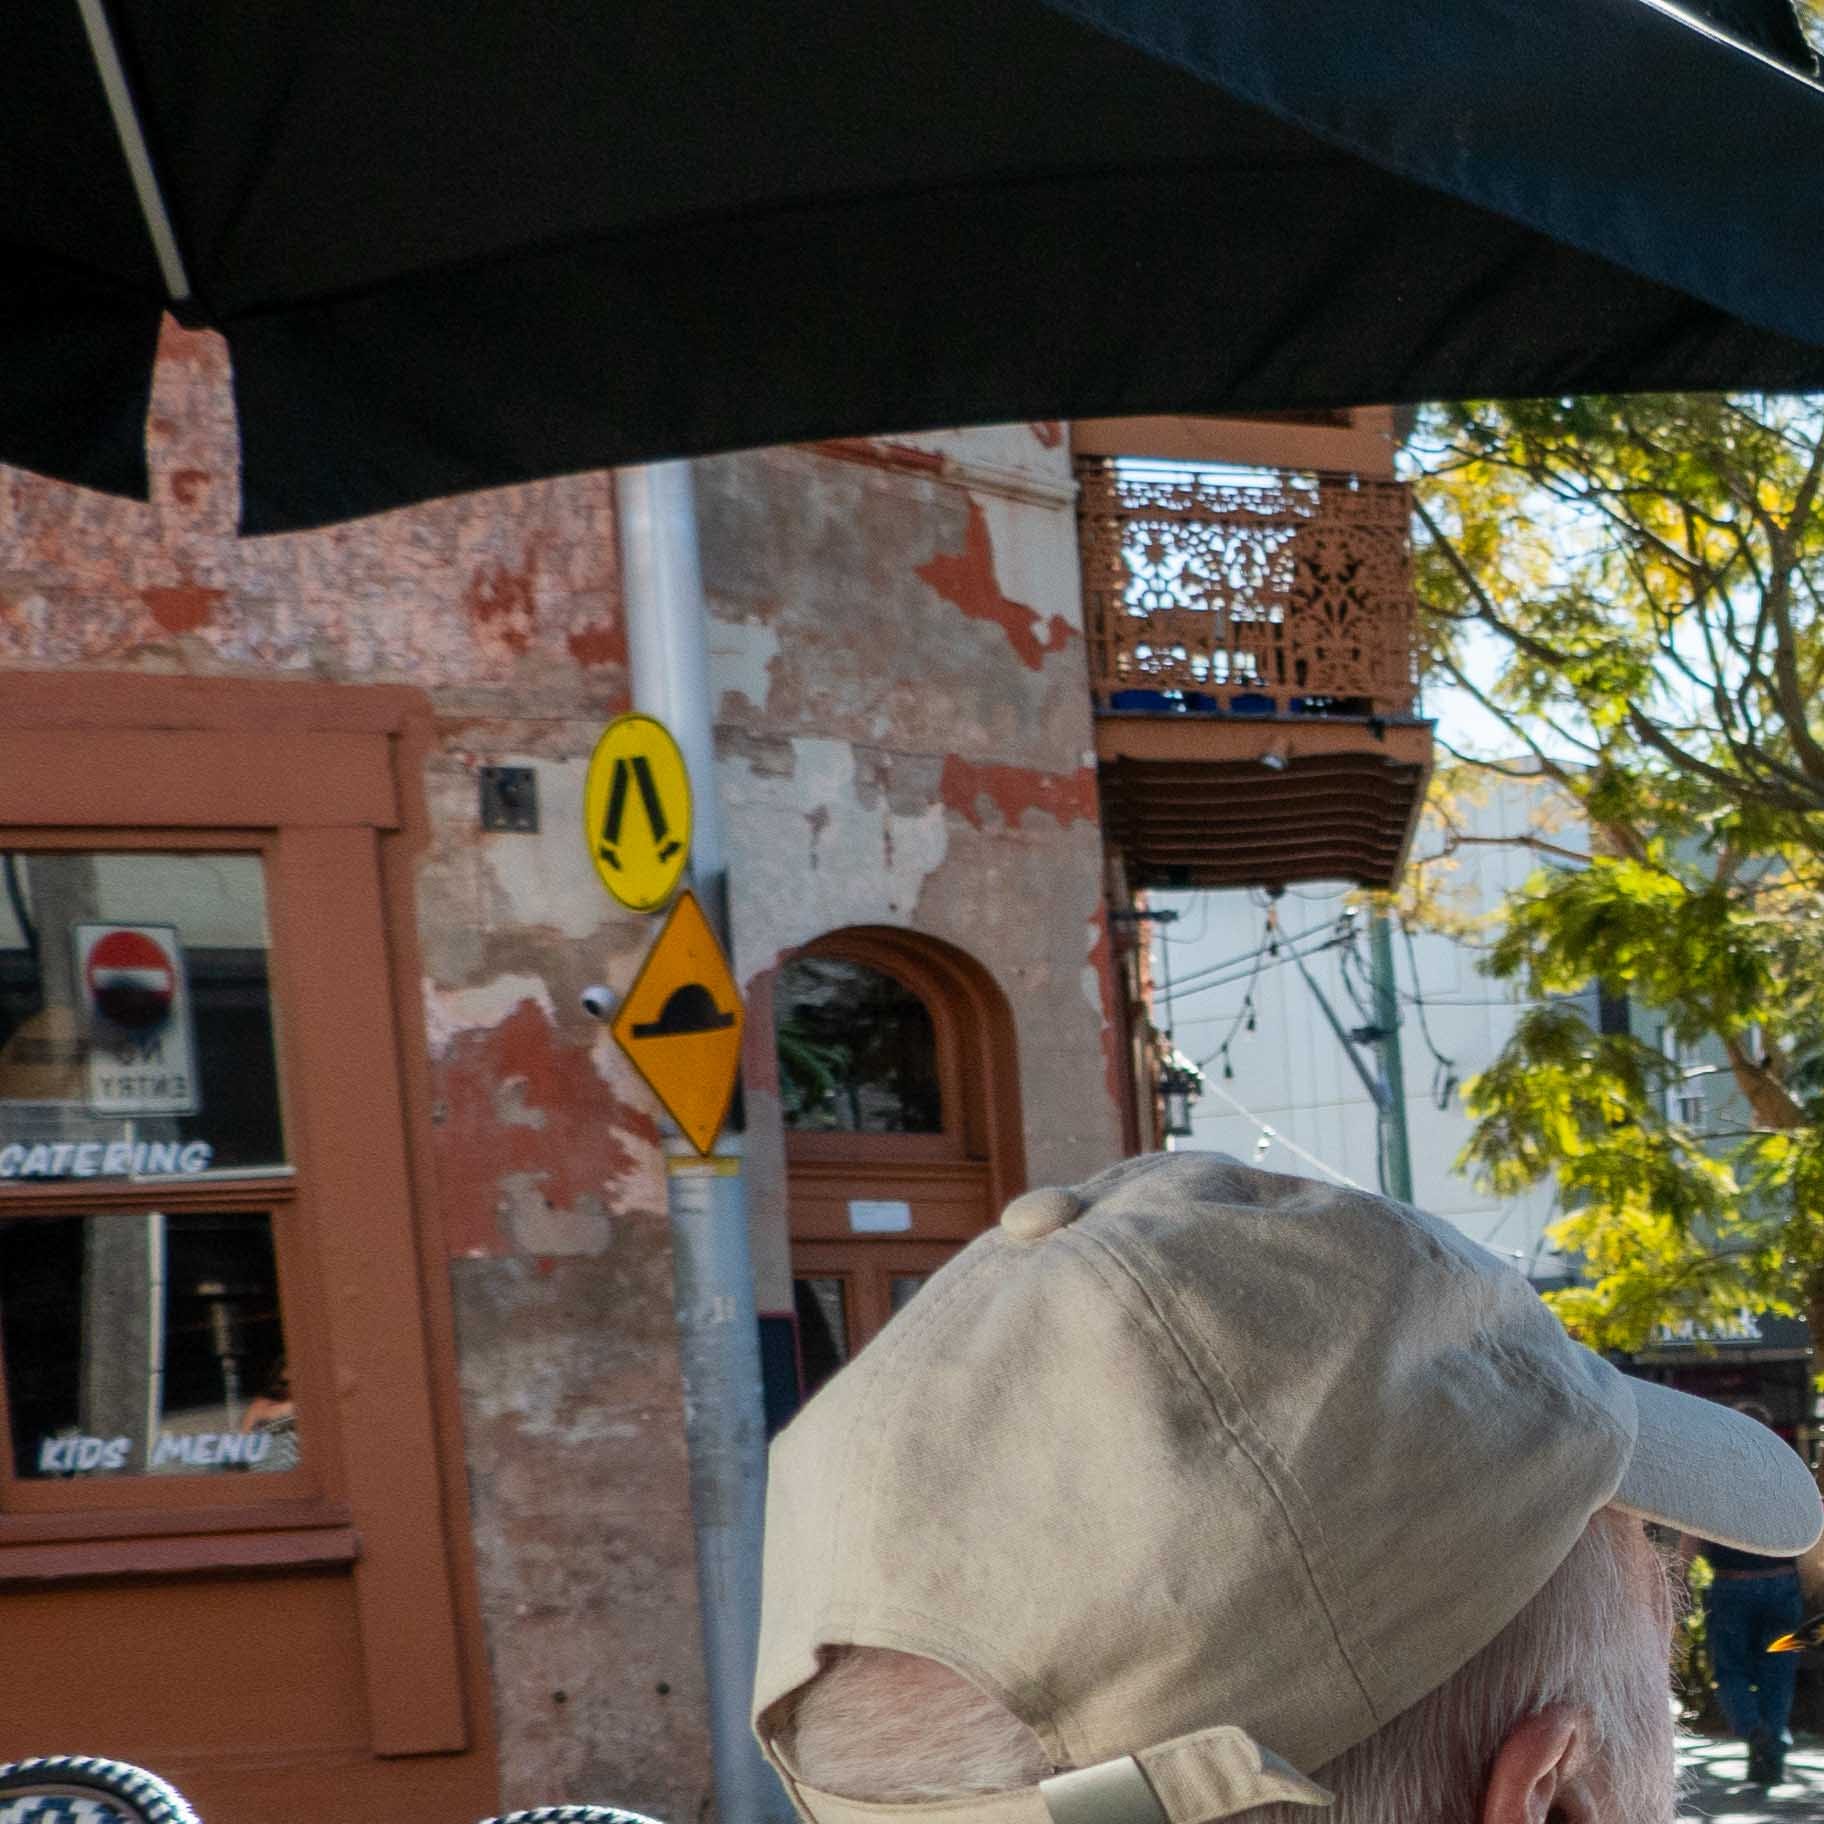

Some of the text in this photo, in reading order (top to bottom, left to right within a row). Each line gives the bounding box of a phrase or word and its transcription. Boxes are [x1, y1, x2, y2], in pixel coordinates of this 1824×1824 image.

[0, 1140, 214, 1178] CATERING
[39, 1432, 273, 1473] KIDS MENU
